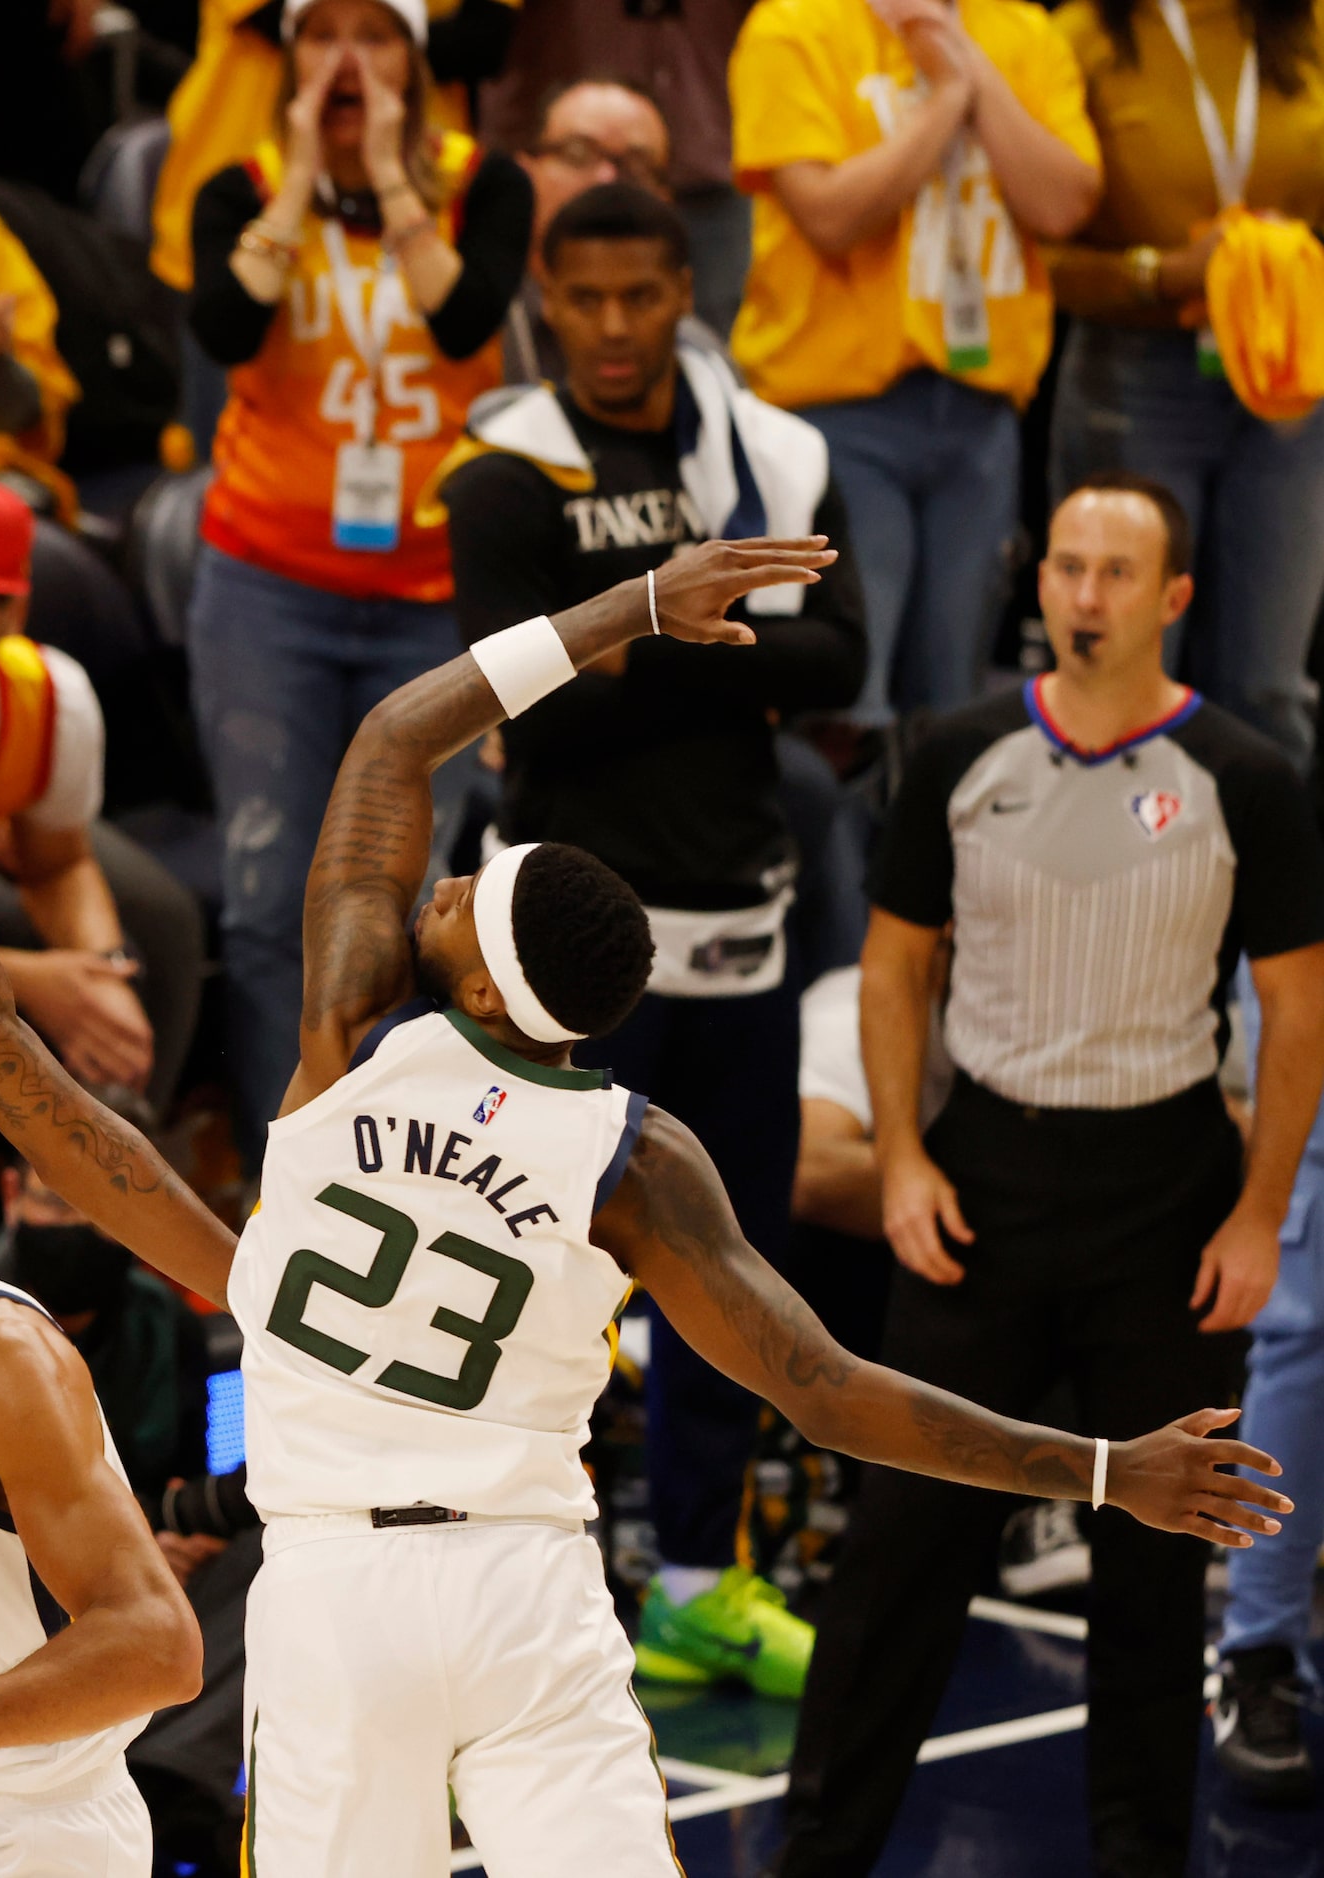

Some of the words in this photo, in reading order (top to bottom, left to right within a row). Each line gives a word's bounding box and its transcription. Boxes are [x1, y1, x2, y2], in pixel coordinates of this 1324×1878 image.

[319, 354, 444, 441] 45
[354, 1115, 559, 1238] O'NEALE
[266, 1182, 534, 1410] 23
